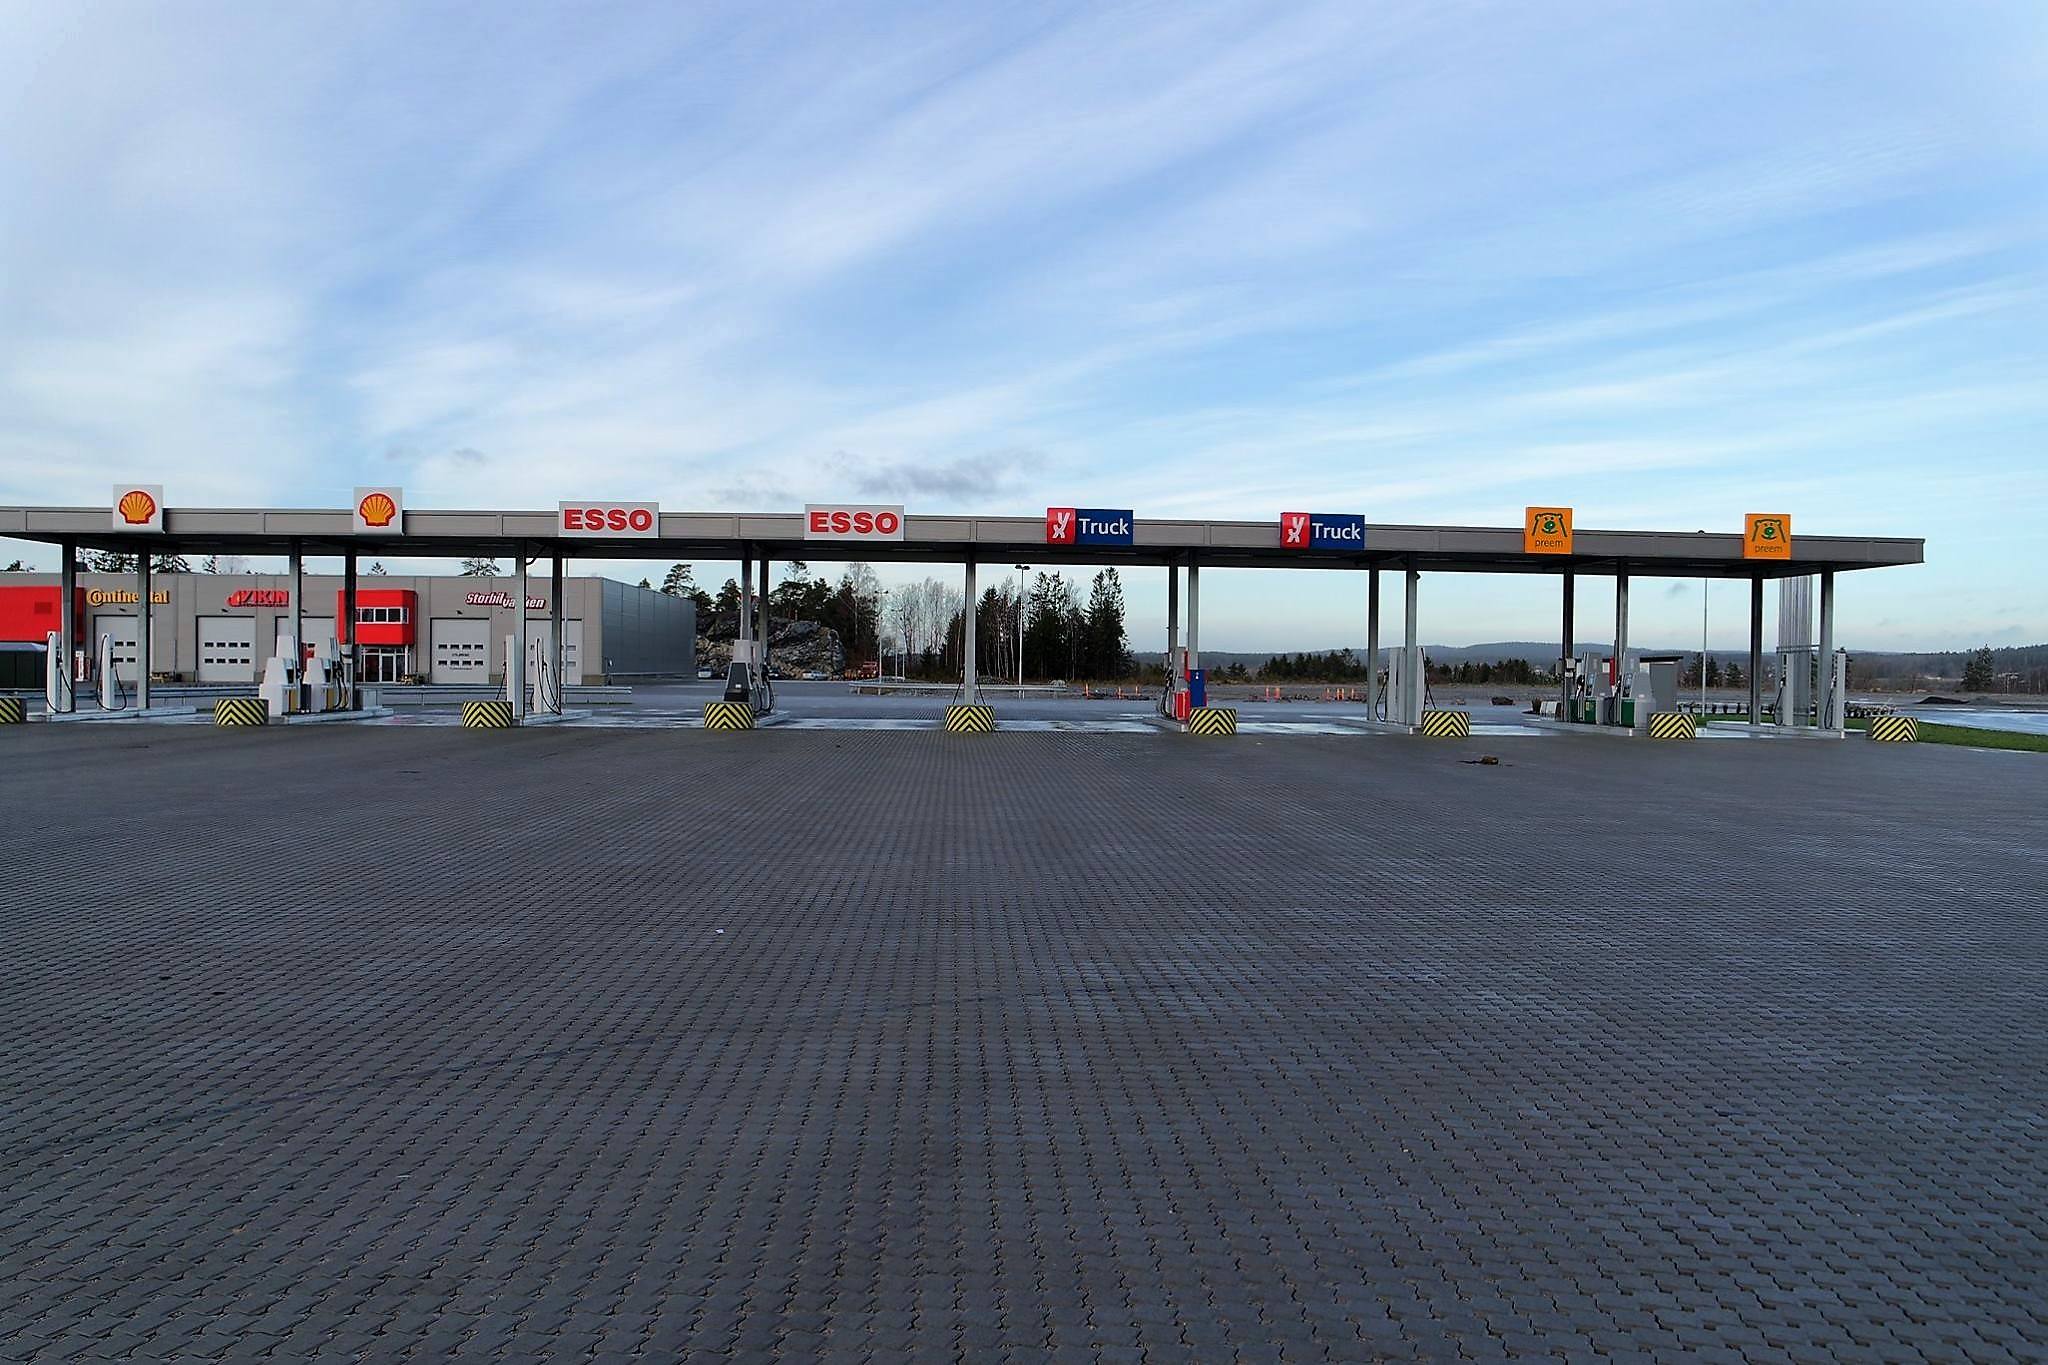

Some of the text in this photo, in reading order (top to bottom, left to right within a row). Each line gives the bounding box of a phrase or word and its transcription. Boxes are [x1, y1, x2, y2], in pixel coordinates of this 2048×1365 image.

[564, 509, 652, 531] ESSO
[810, 512, 898, 534] ESSO
[1079, 518, 1129, 535] Truck
[1311, 522, 1361, 540] Truck
[1535, 540, 1563, 549] preem
[1754, 545, 1782, 553] preem
